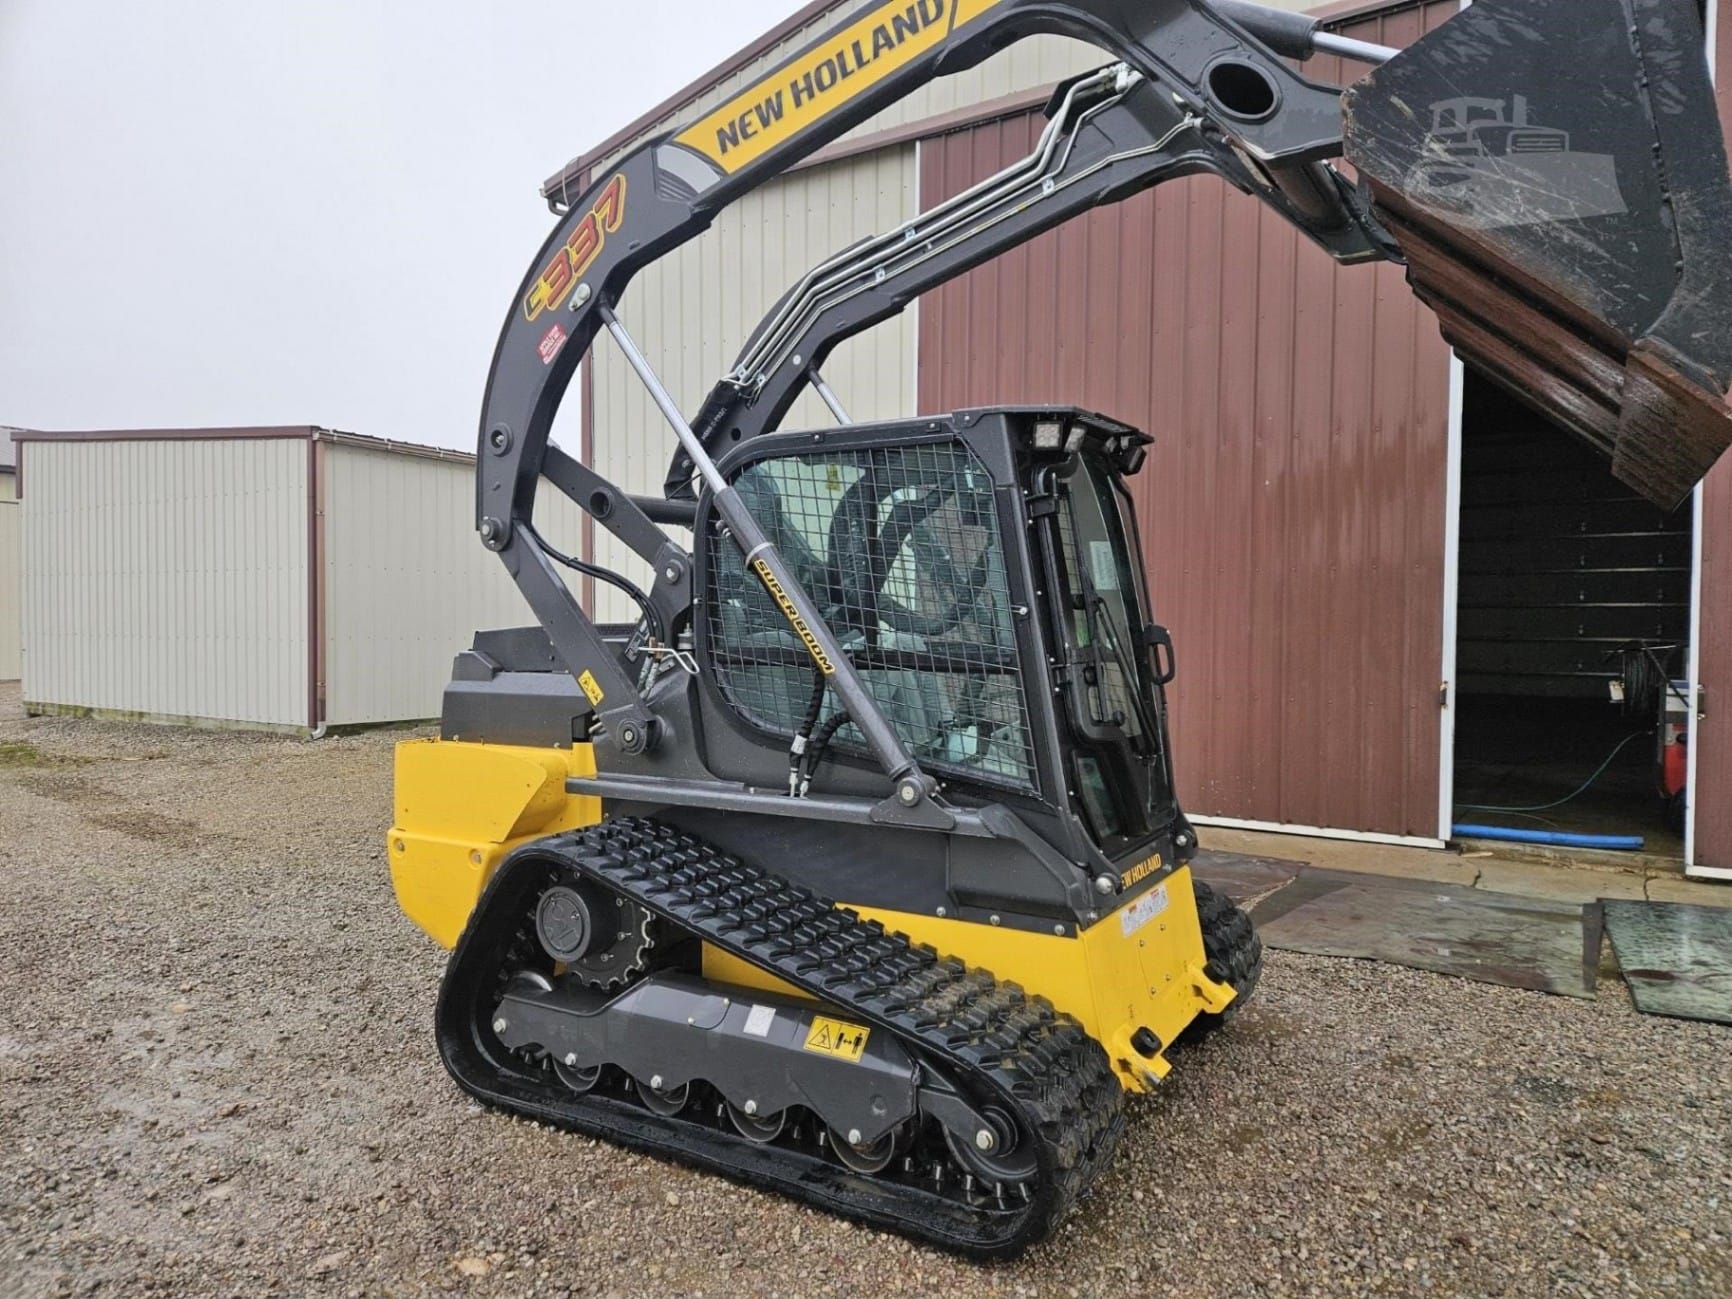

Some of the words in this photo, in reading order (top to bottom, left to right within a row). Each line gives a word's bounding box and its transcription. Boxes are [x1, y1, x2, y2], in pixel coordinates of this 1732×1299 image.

[716, 89, 784, 154] NEW
[790, 0, 944, 109] HOLLAND
[525, 174, 625, 320] C337
[755, 560, 798, 619] SUPER
[795, 620, 834, 673] BOOM
[1131, 853, 1162, 883] HOLLAND
